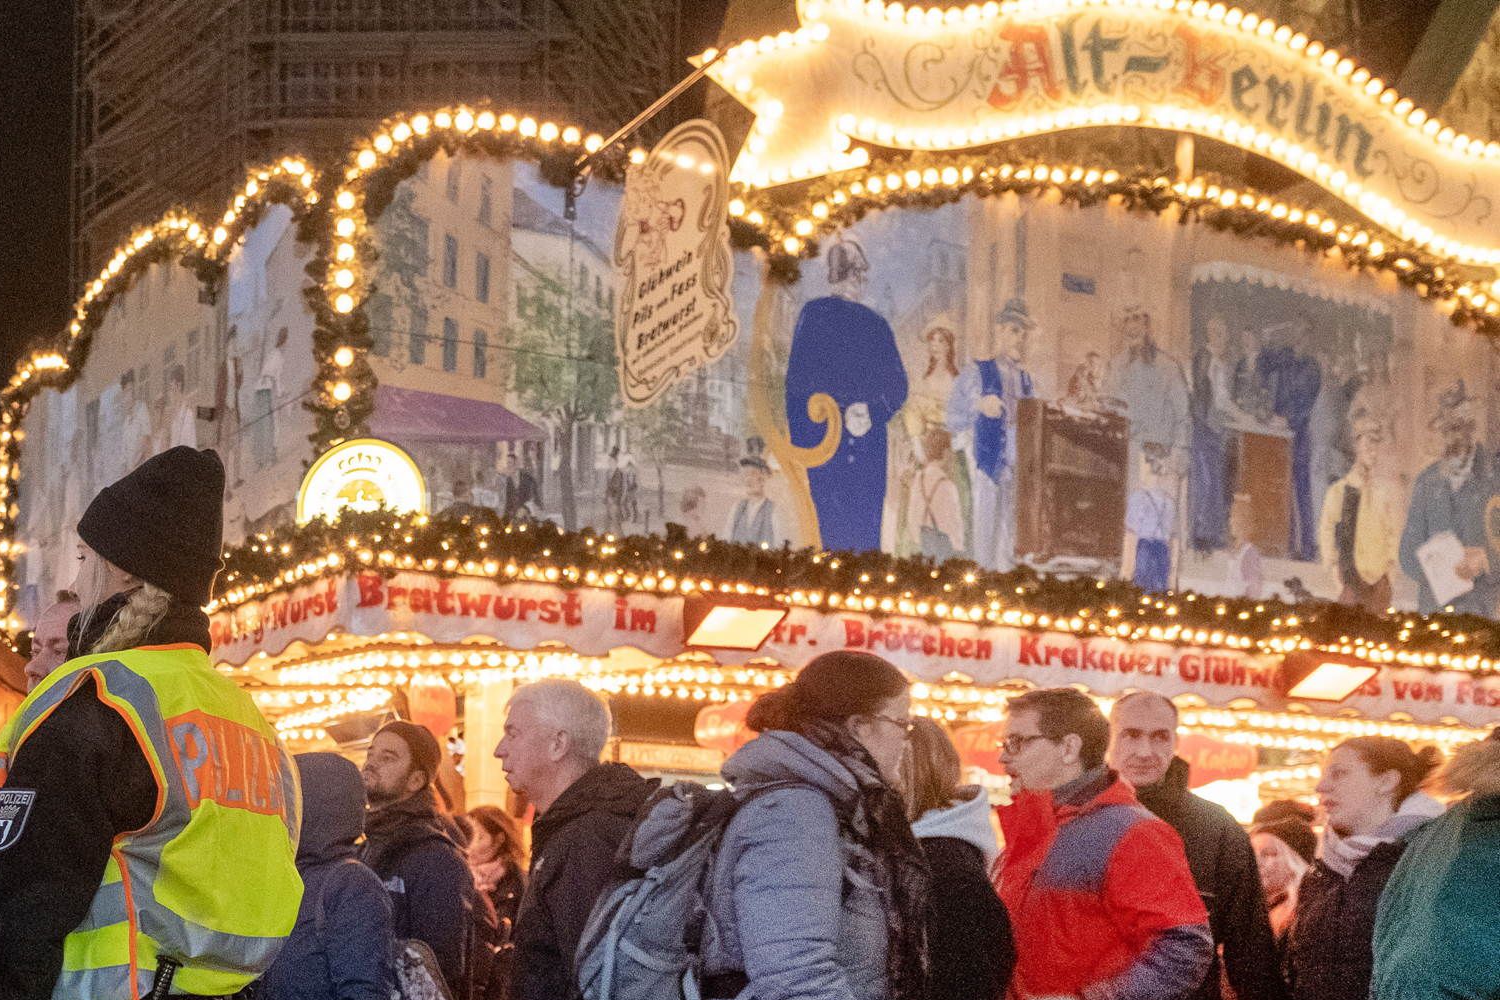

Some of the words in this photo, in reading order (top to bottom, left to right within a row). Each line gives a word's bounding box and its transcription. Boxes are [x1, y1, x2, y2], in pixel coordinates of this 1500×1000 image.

[356, 574, 583, 627] Bratwurst
[614, 599, 657, 633] im
[843, 618, 993, 660] Brötchen
[1017, 632, 1172, 676] Krakauer
[1456, 680, 1500, 707] Fas
